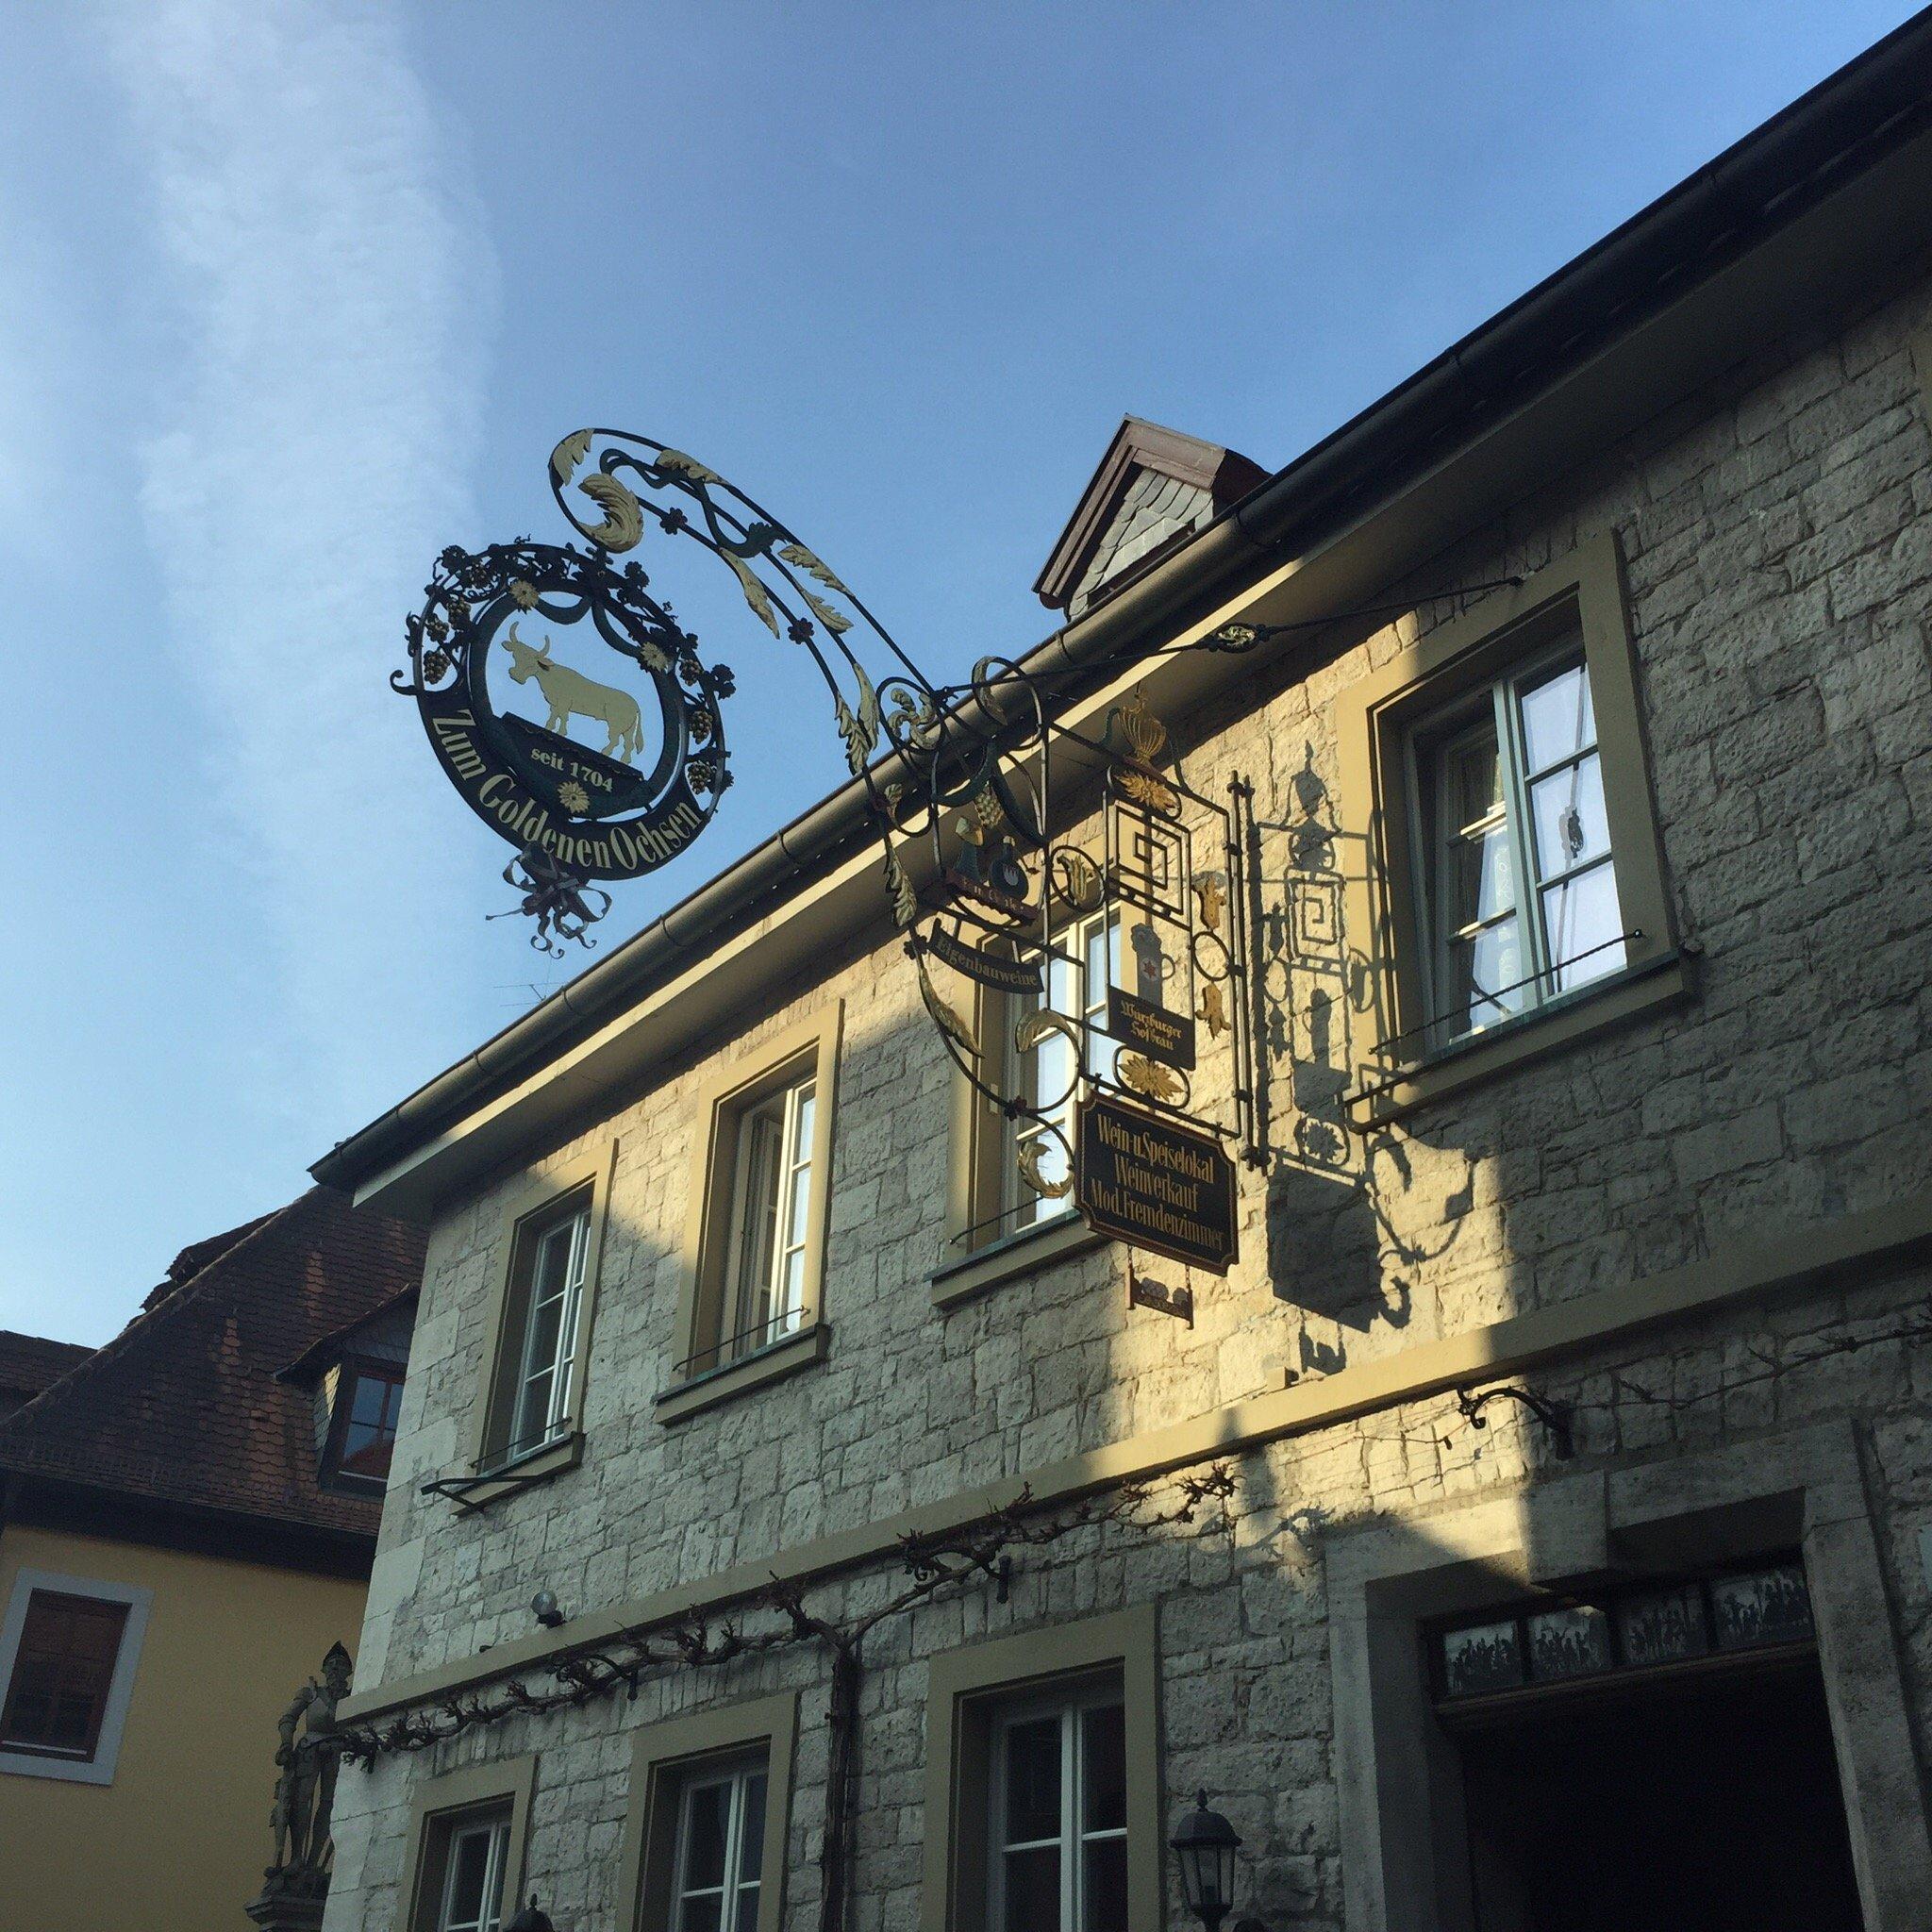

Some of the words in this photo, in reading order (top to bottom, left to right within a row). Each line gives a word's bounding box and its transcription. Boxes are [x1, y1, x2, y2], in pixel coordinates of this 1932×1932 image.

[432, 708, 487, 781] Zum
[478, 774, 613, 869] Goldenen
[609, 801, 703, 871] Ochsen
[530, 747, 566, 772] seit
[570, 761, 614, 793] 1704
[1091, 1176, 1123, 1217] Mod.
[1123, 1190, 1224, 1252] Fremdenzimmer
[1114, 1153, 1199, 1213] Weinverkauf
